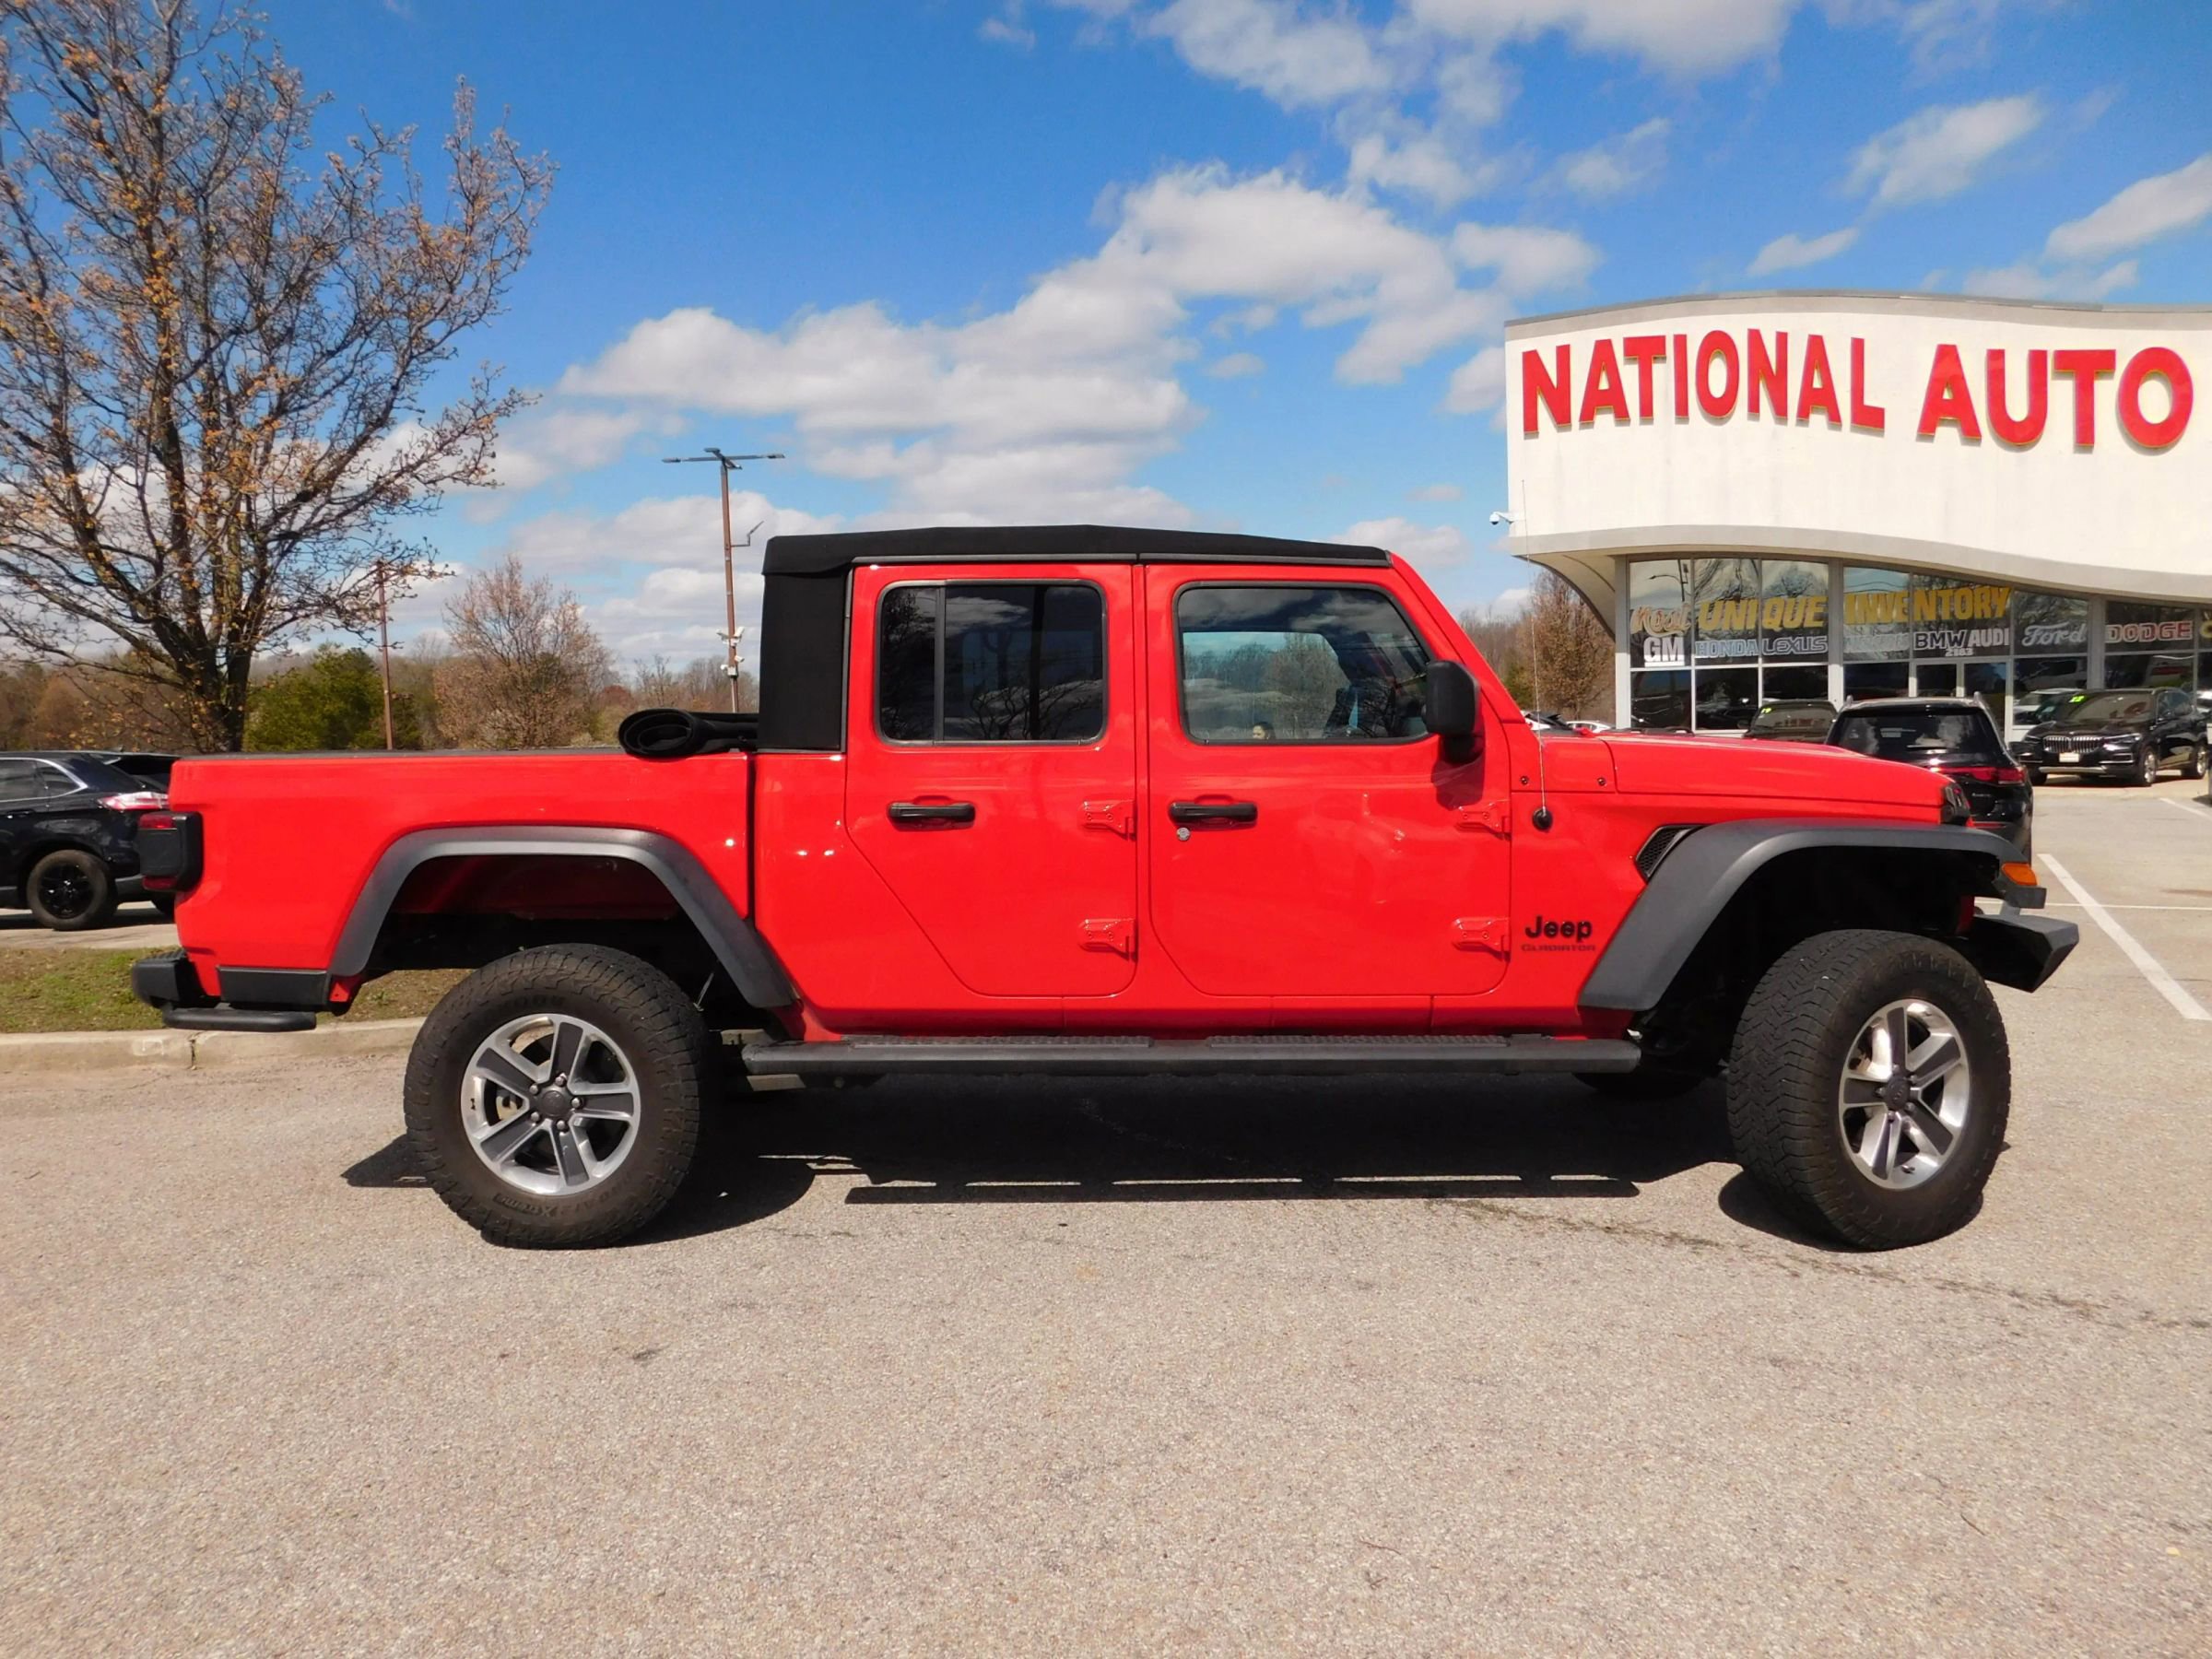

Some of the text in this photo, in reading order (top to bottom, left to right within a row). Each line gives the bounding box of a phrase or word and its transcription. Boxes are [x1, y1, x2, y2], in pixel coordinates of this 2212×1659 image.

[1522, 328, 2194, 449] NATIONAL AUTO
[1698, 596, 1829, 631] UNIQUE
[1844, 586, 2011, 625] INVENTORY
[1913, 629, 1968, 651] BMW
[1968, 628, 2009, 647] AUDI
[2021, 621, 2087, 647] Ford
[2104, 620, 2194, 643] DODGE
[1643, 637, 1685, 663] GM
[1695, 638, 1759, 659] HONDA
[1762, 635, 1829, 656] LEXUS
[1524, 915, 1593, 942] Jeep
